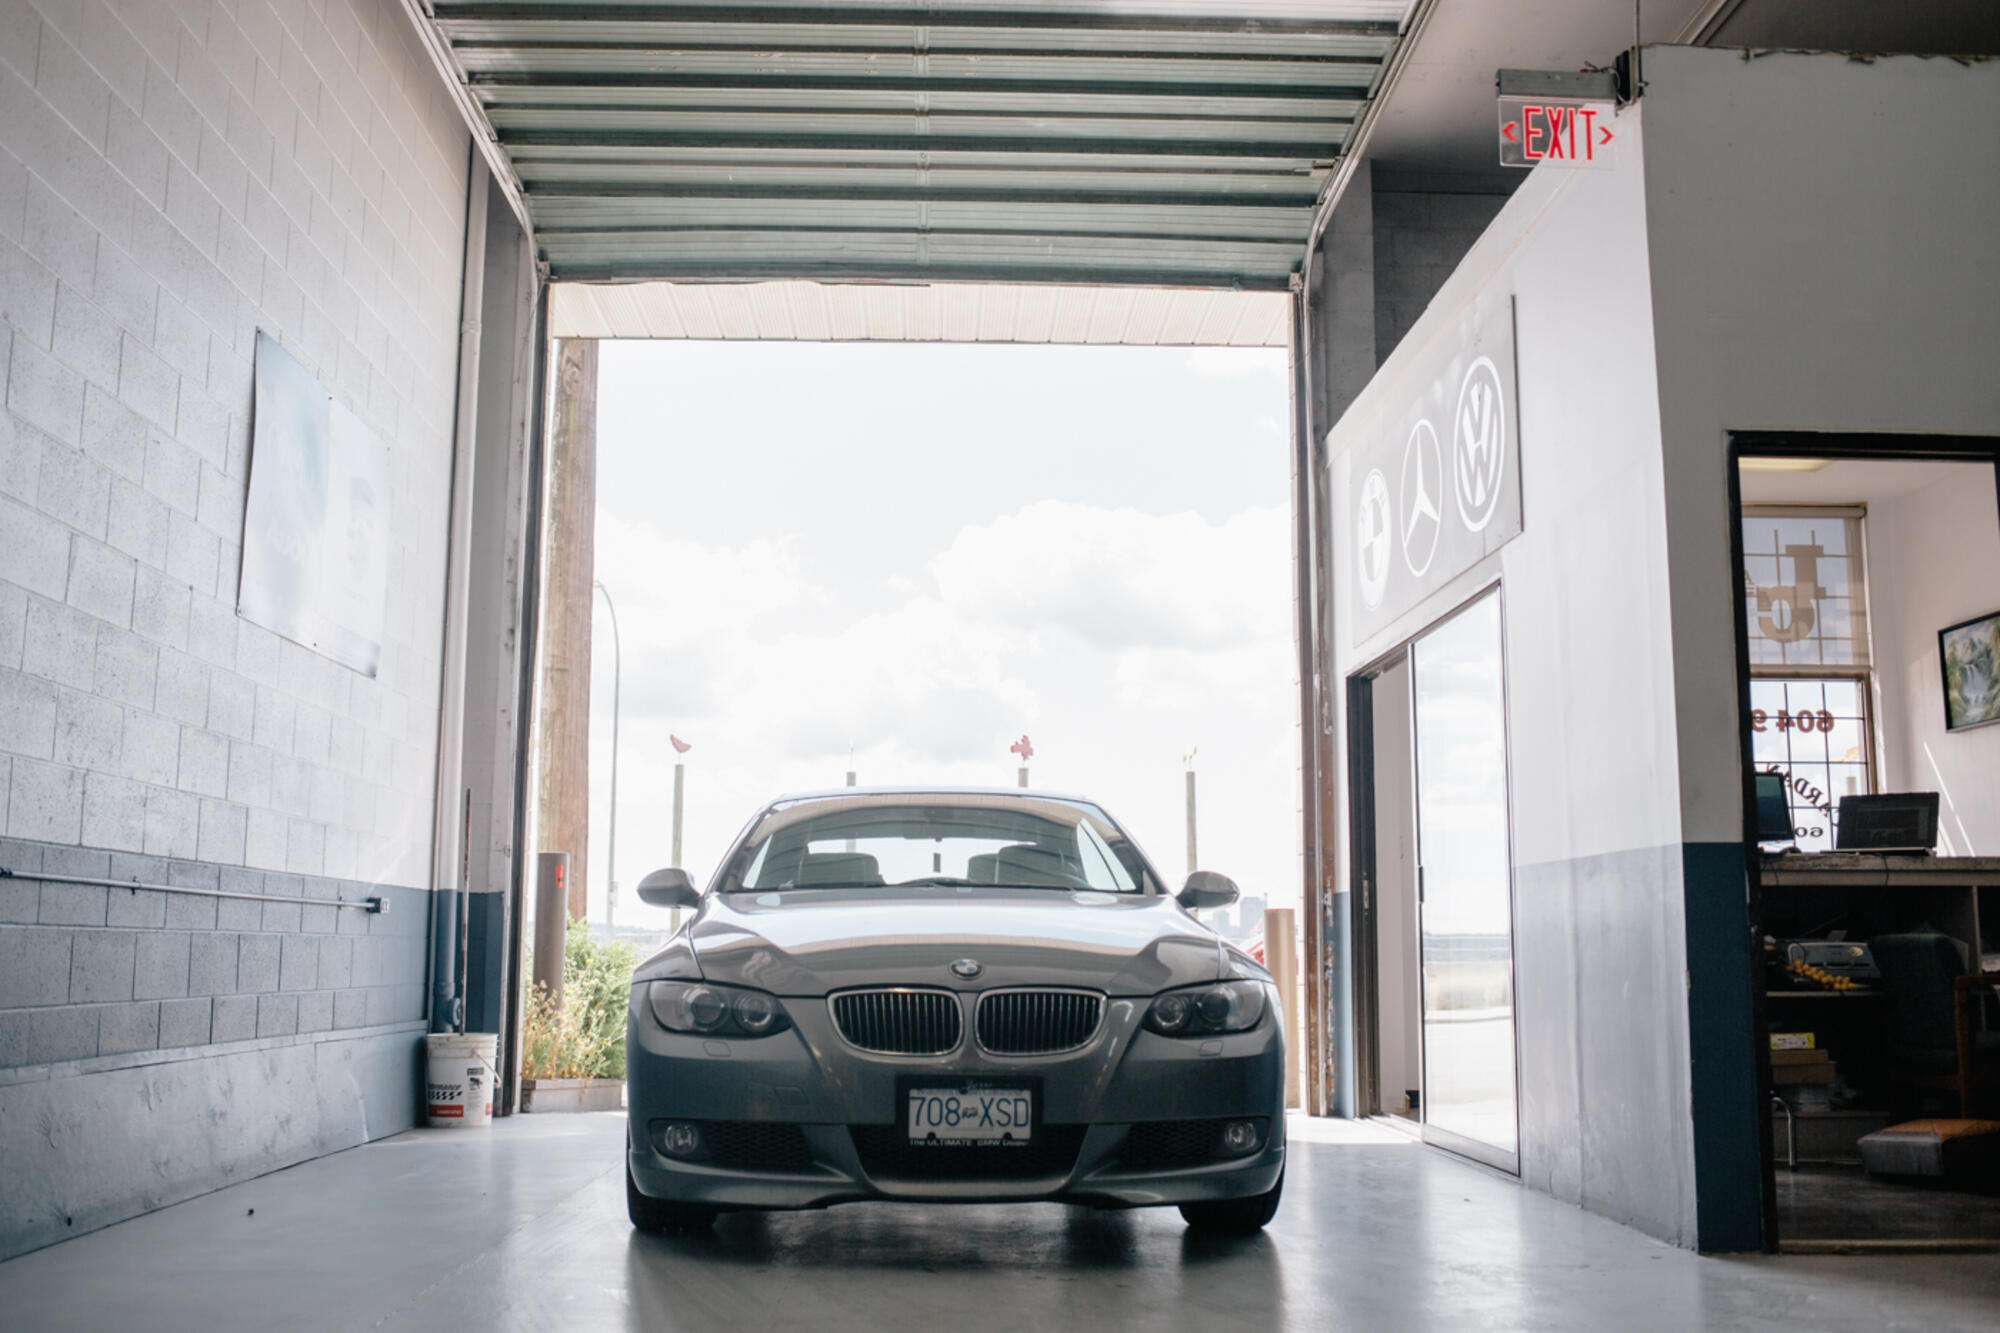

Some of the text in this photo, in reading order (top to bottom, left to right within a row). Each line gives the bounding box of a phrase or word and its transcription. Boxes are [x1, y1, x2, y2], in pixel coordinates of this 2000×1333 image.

[1522, 105, 1597, 160] EXIT
[909, 1096, 1030, 1128] 708 XSD
